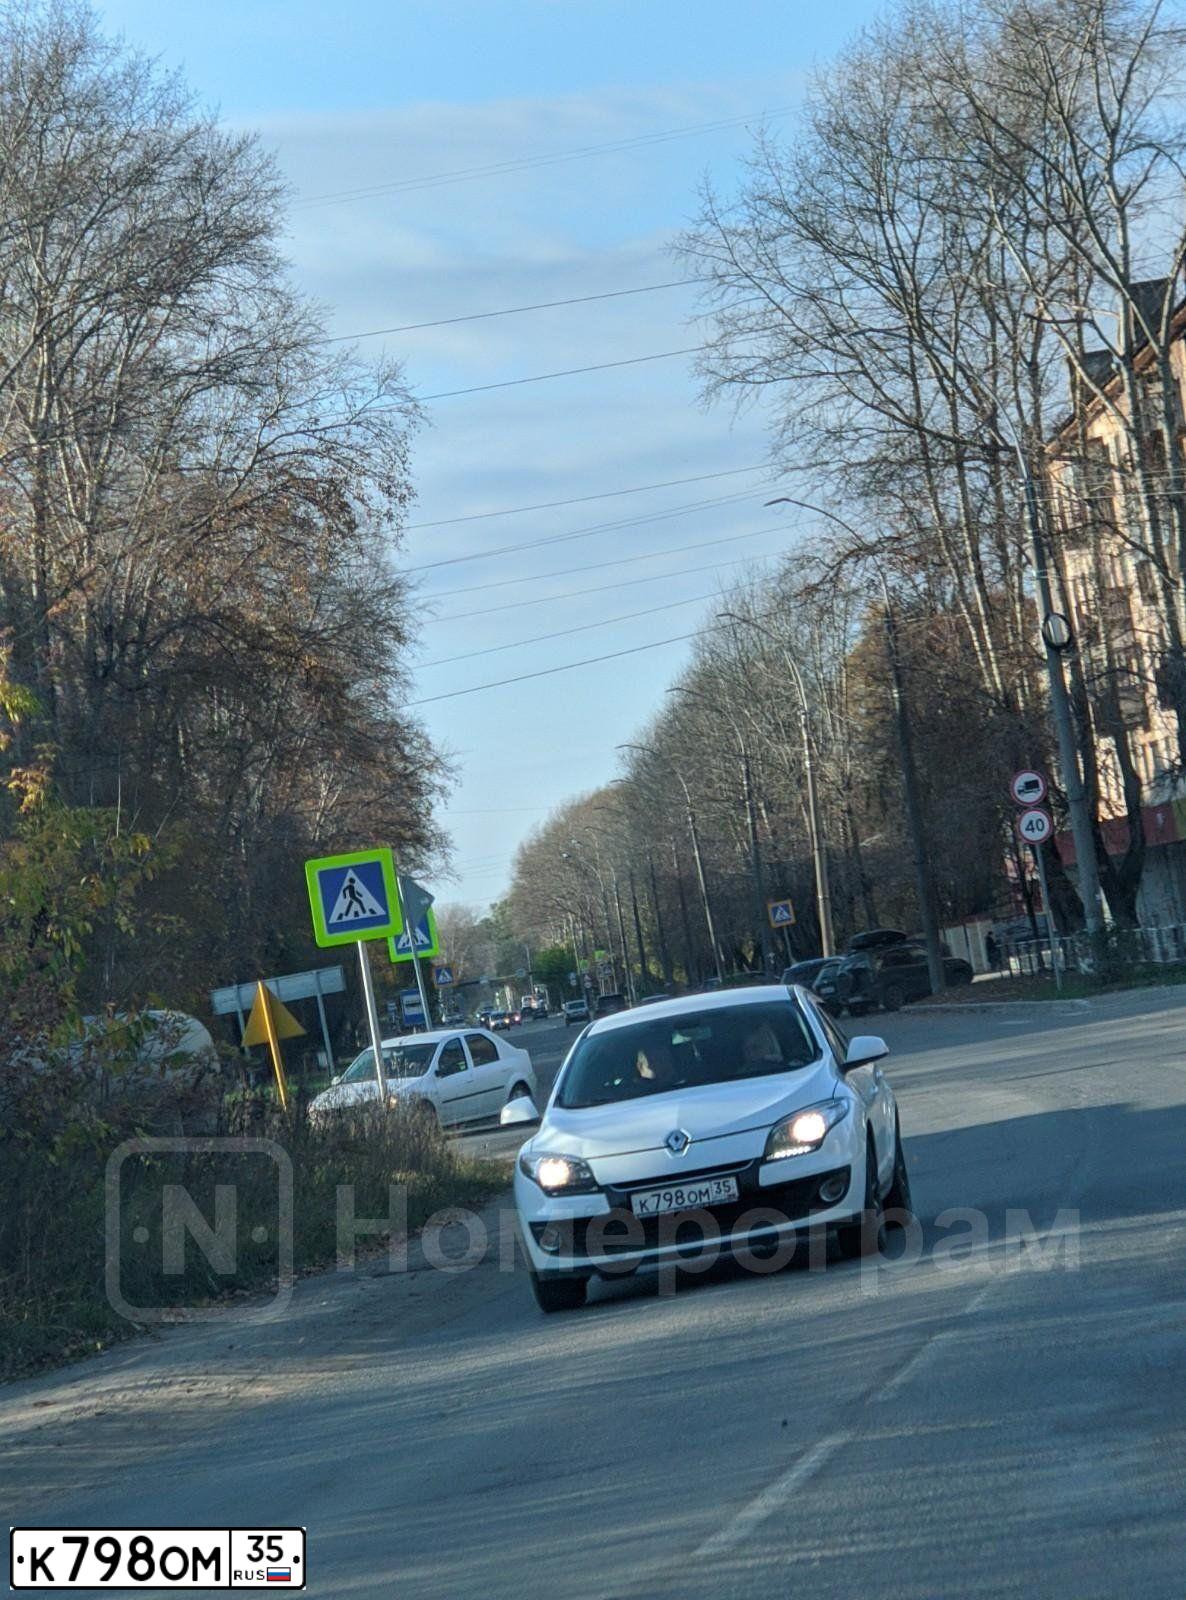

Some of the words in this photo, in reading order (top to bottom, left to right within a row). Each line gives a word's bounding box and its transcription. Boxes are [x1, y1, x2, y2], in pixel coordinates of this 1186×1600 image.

[1025, 818, 1045, 833] 40
[639, 1188, 711, 1213] К798ОМ
[713, 1181, 732, 1194] 35
